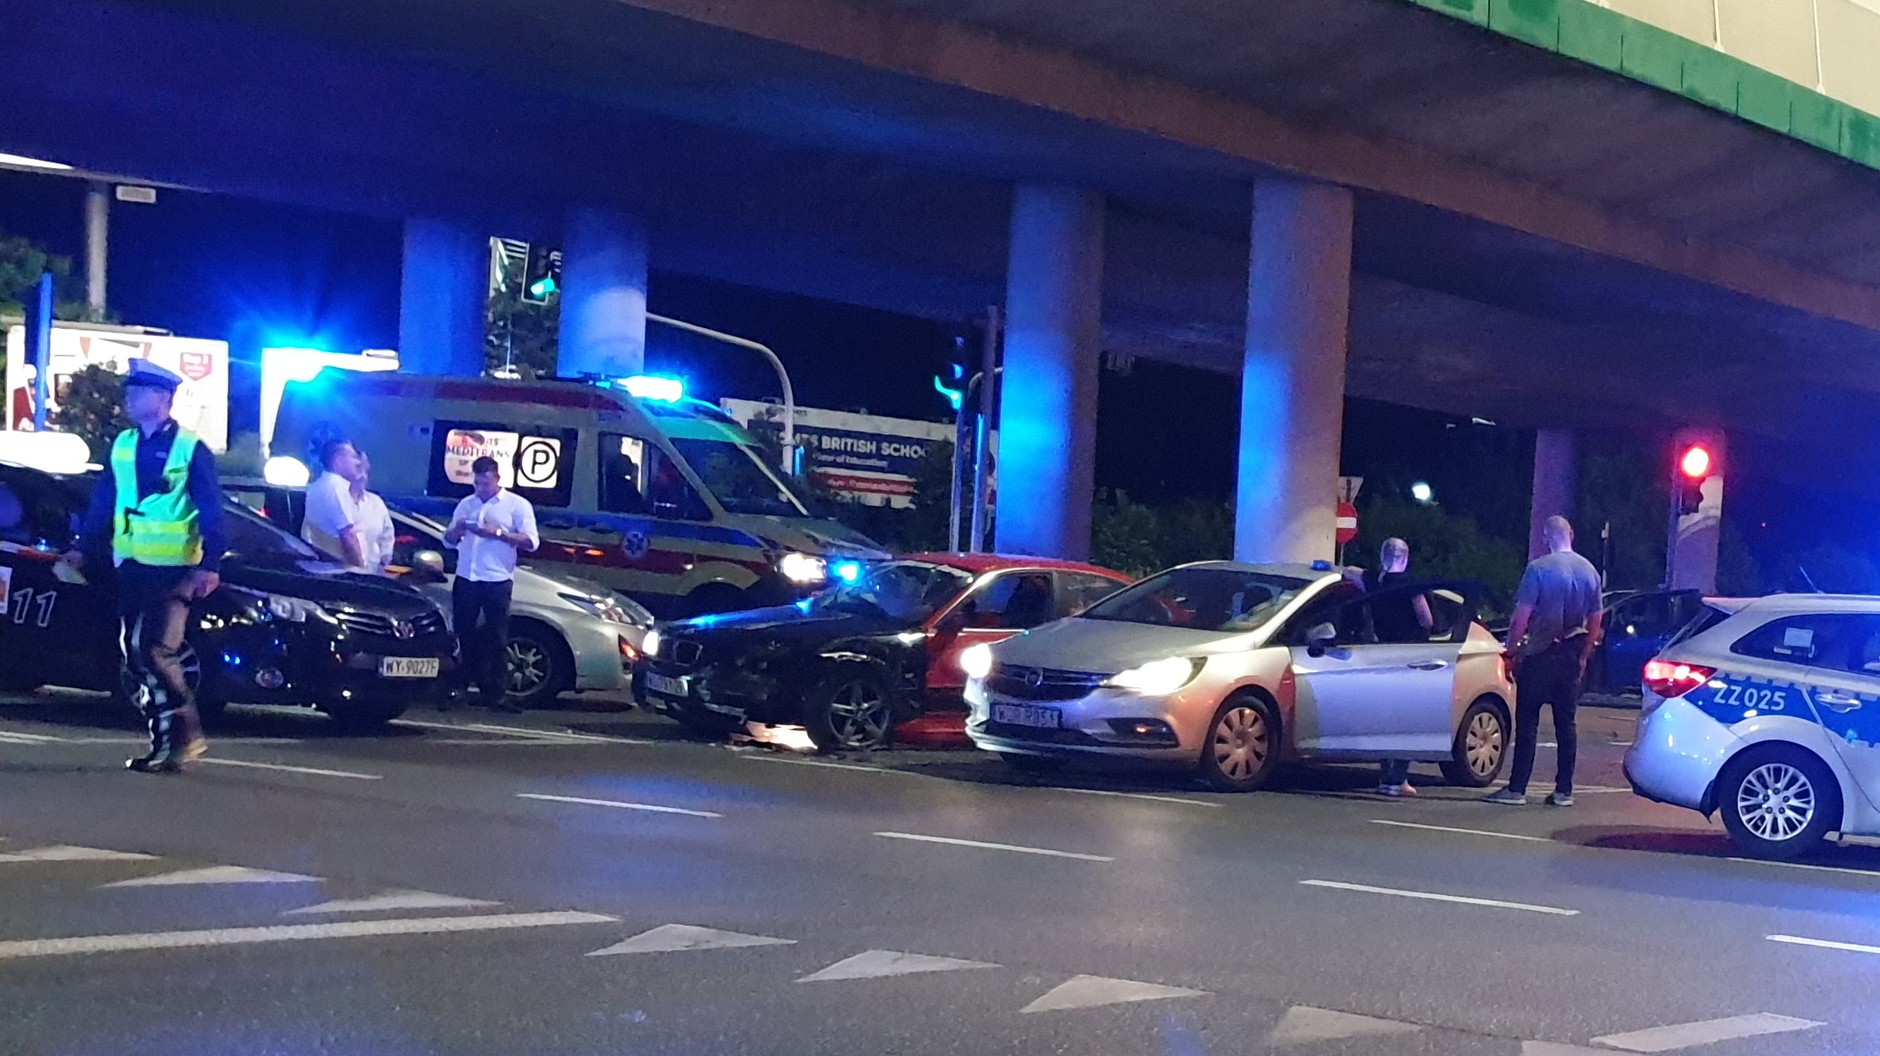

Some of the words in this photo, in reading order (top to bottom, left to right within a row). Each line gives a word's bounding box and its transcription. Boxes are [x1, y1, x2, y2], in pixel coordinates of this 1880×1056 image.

[821, 435, 877, 454] BRITISH
[531, 449, 550, 475] P
[13, 587, 57, 628] 11
